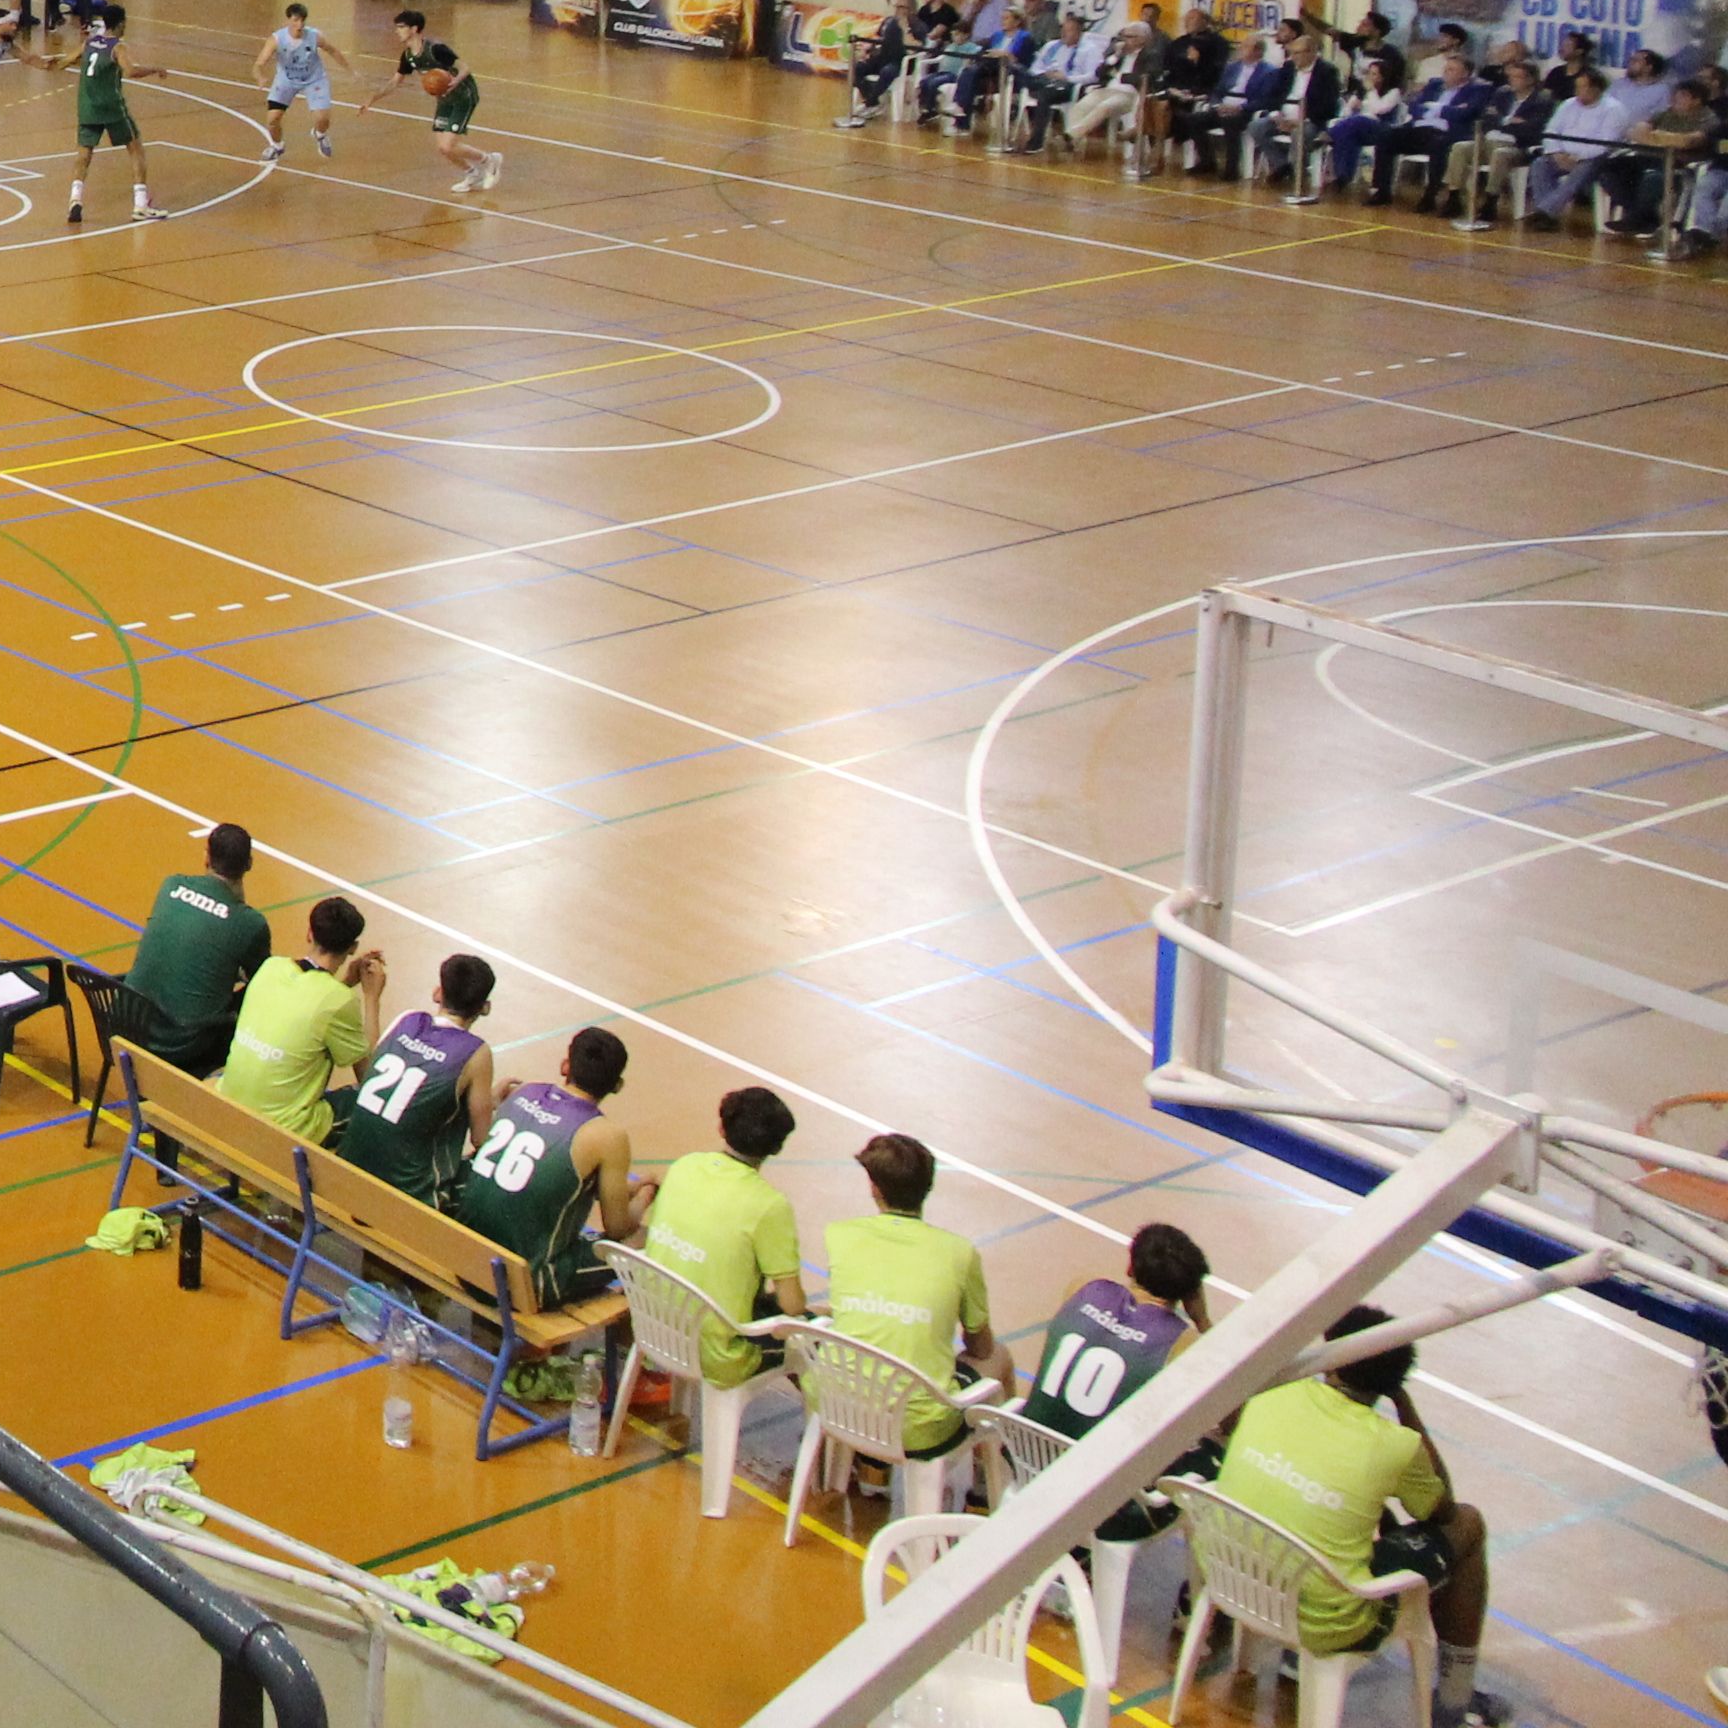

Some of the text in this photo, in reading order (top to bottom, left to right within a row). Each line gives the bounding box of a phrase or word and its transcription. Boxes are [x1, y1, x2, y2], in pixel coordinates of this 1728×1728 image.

[356, 1053, 428, 1125] 21
[471, 1118, 545, 1193] 26
[1041, 1332, 1126, 1418] 10
